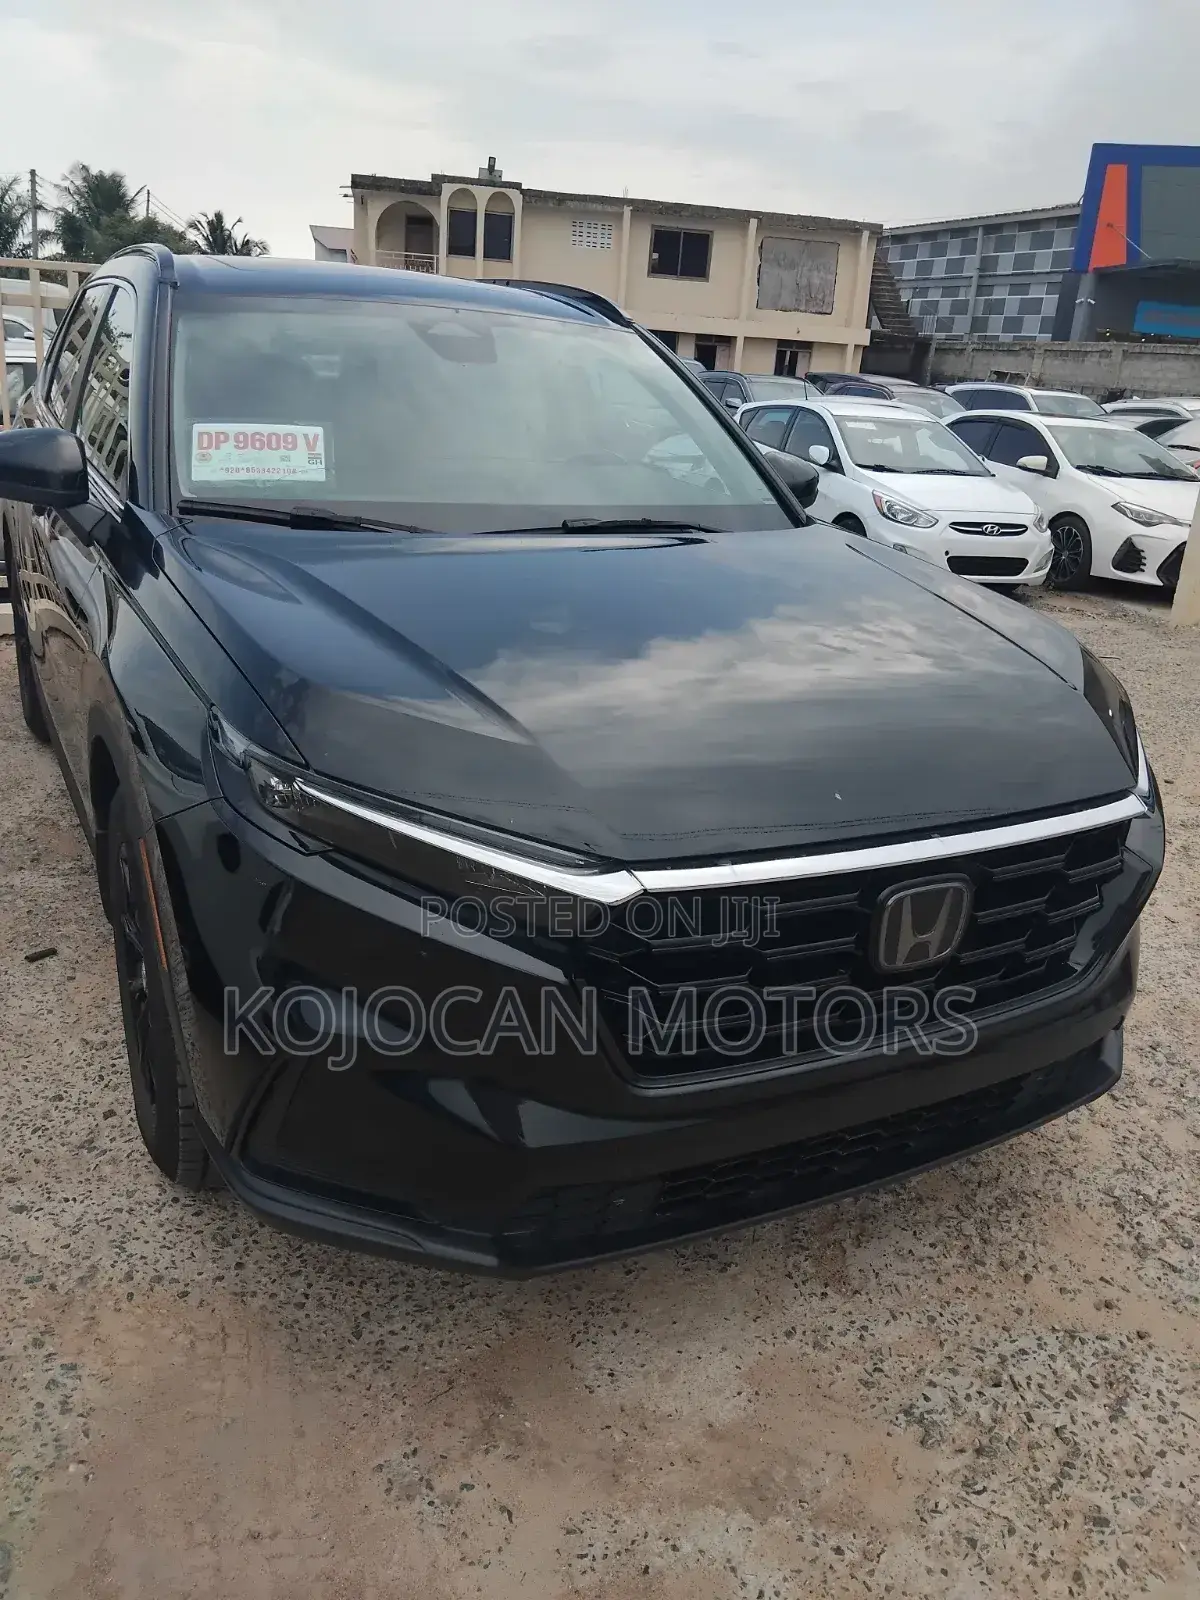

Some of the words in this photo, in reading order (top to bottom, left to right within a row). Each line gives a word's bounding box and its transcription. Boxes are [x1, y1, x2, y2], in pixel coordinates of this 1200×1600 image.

[197, 431, 230, 451] DP
[233, 431, 298, 452] 9609
[302, 433, 320, 452] V
